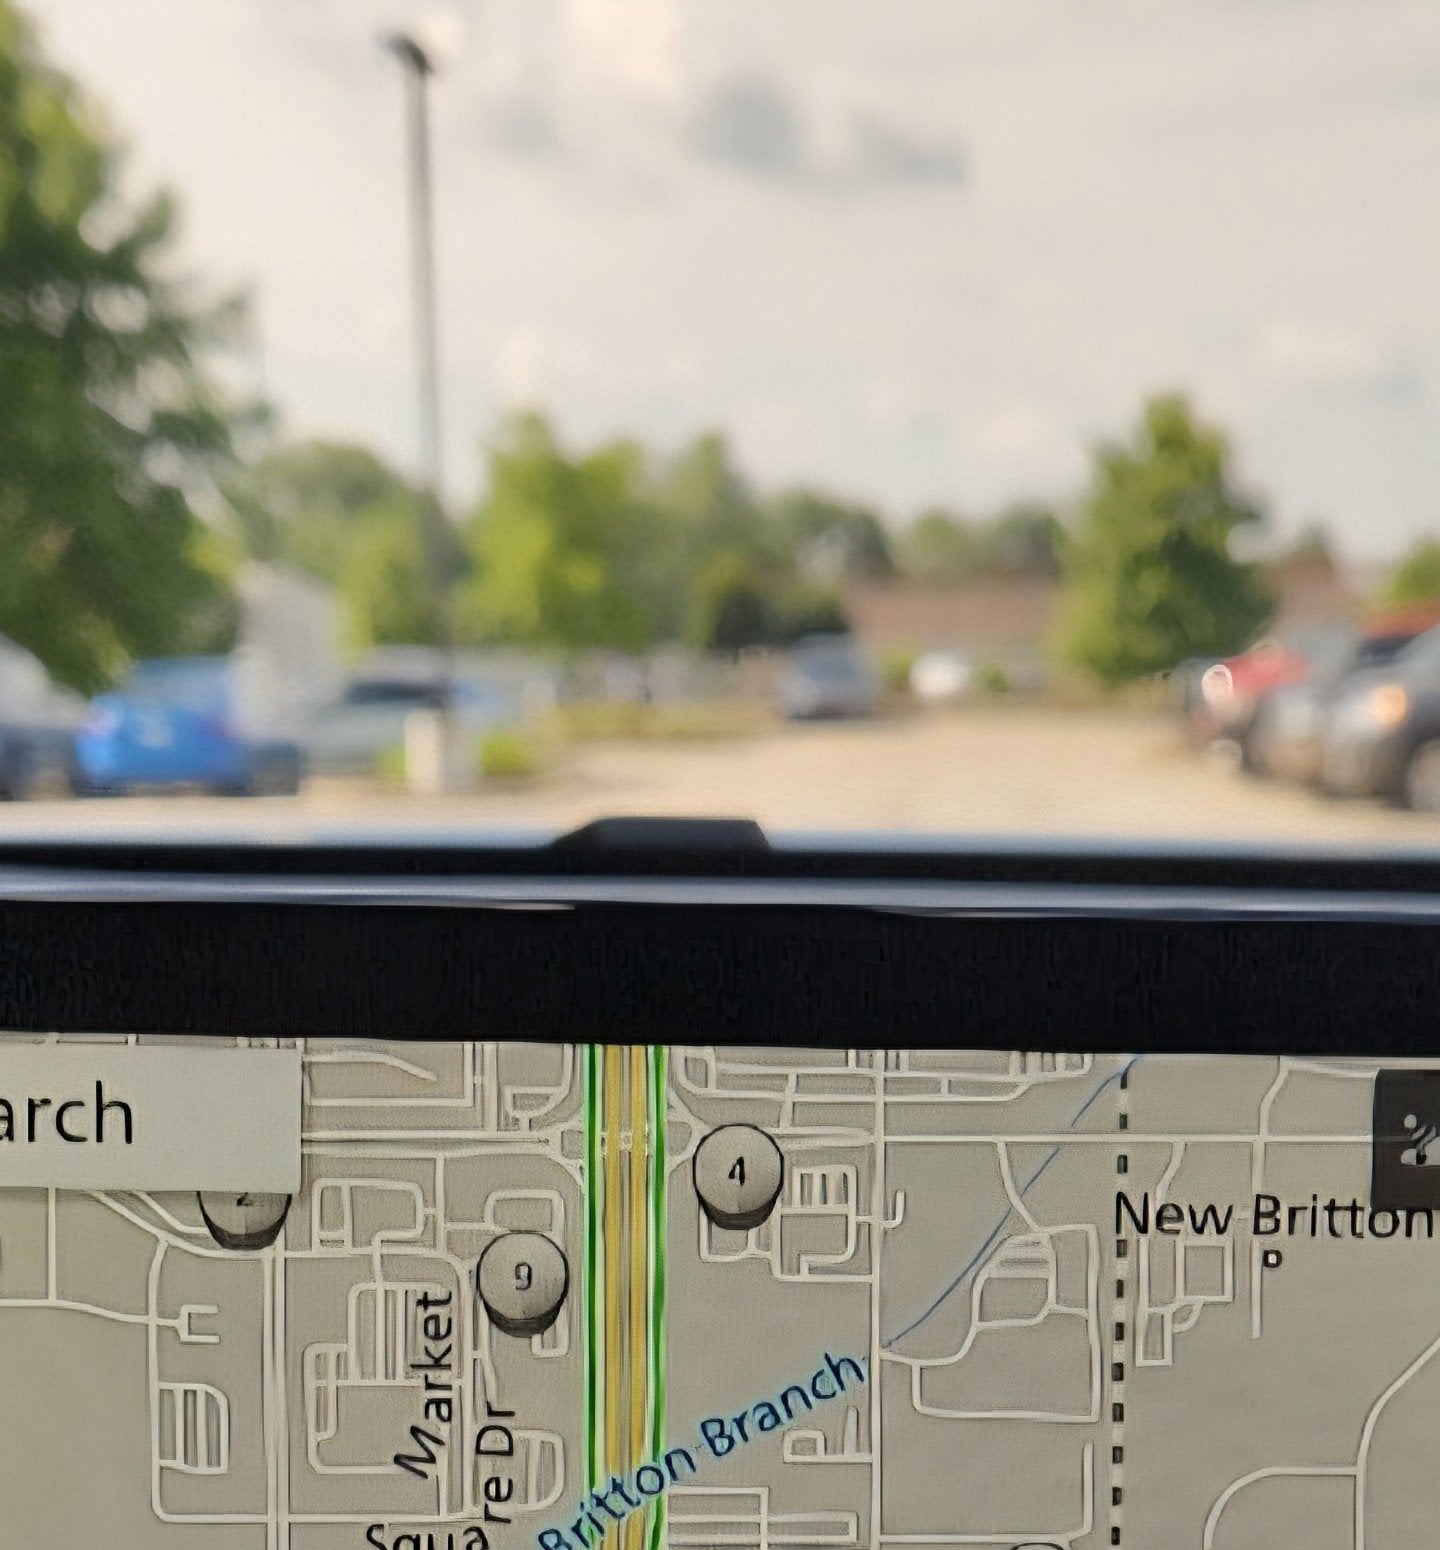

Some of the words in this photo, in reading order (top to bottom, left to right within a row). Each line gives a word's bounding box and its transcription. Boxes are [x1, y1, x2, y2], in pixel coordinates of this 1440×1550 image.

[1114, 1190, 1234, 1236] New
[1253, 1192, 1435, 1239] Britton
[393, 1290, 453, 1480] Market
[475, 1400, 516, 1457] Dr
[699, 1351, 866, 1458] Branch
